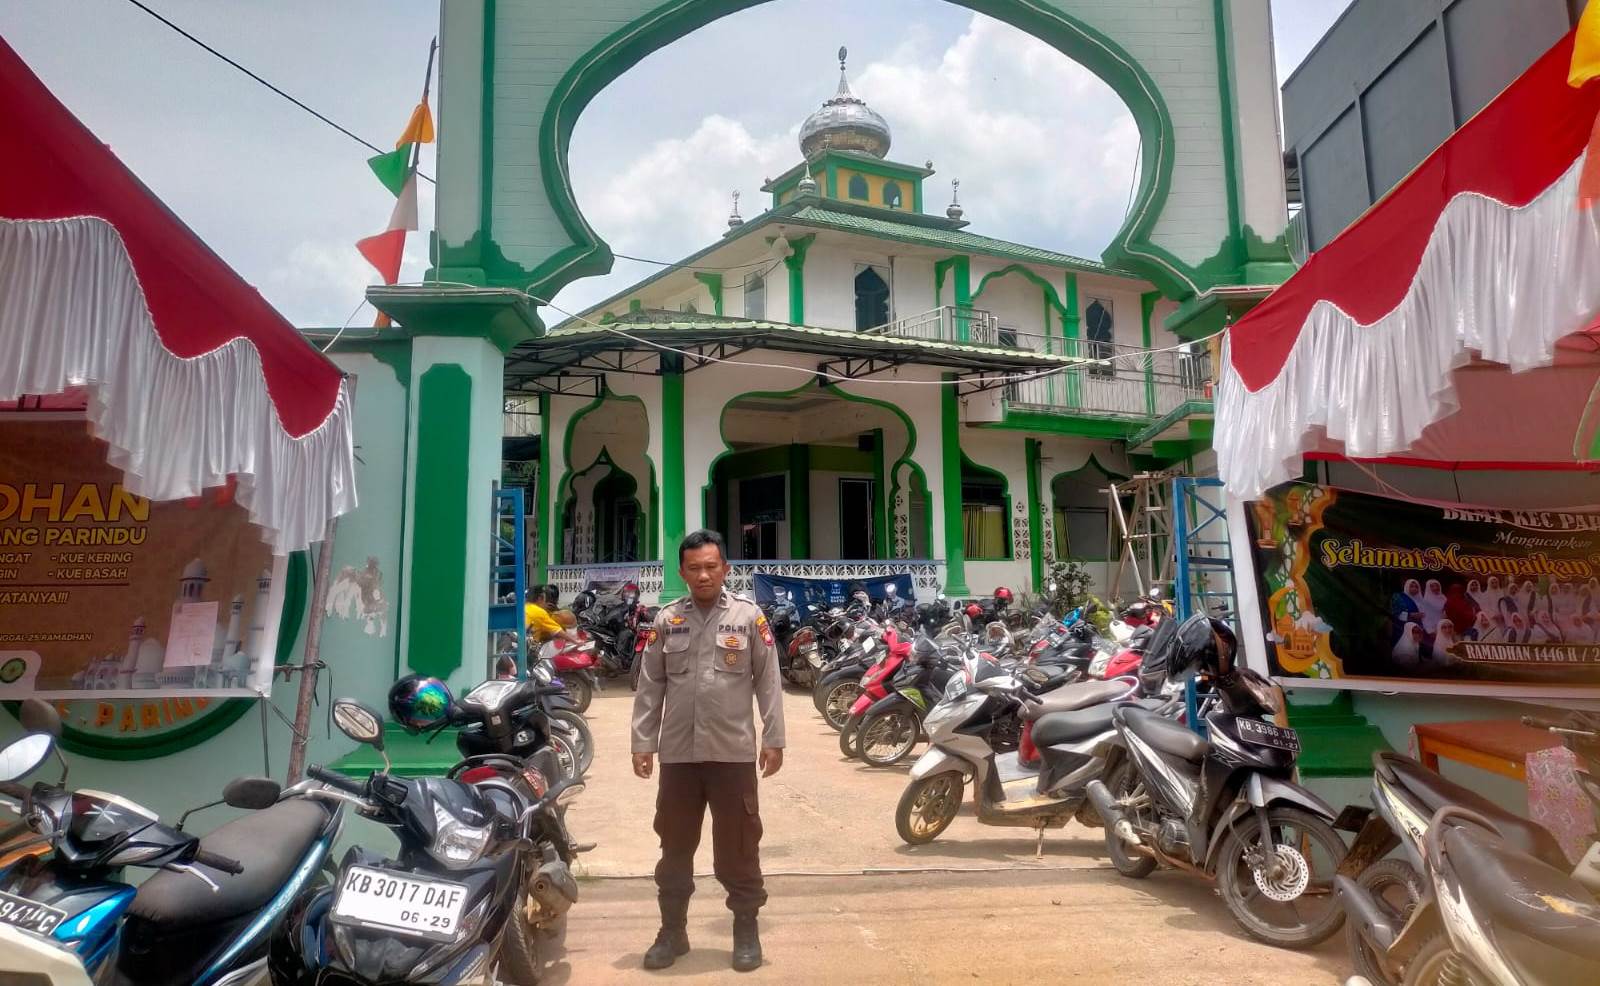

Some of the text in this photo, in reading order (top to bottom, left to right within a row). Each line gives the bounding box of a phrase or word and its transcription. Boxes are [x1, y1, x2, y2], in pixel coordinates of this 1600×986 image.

[0, 528, 146, 545] NG PARINDU
[1492, 530, 1593, 550] Mengucapkan
[60, 553, 85, 563] KUE
[87, 553, 132, 563] KERING
[1321, 539, 1593, 580] Selamat Menunaikan
[57, 568, 81, 579] KUE
[85, 568, 128, 579] BASAH
[41, 633, 92, 641] RAMADHAN
[718, 625, 747, 633] POLRI
[1465, 644, 1531, 660] RAMADHAN
[1533, 647, 1564, 661] 1446
[1567, 647, 1578, 661] H
[1239, 720, 1252, 731] KB
[1255, 723, 1279, 737] 3986
[346, 872, 460, 908] KB 3017 DAF
